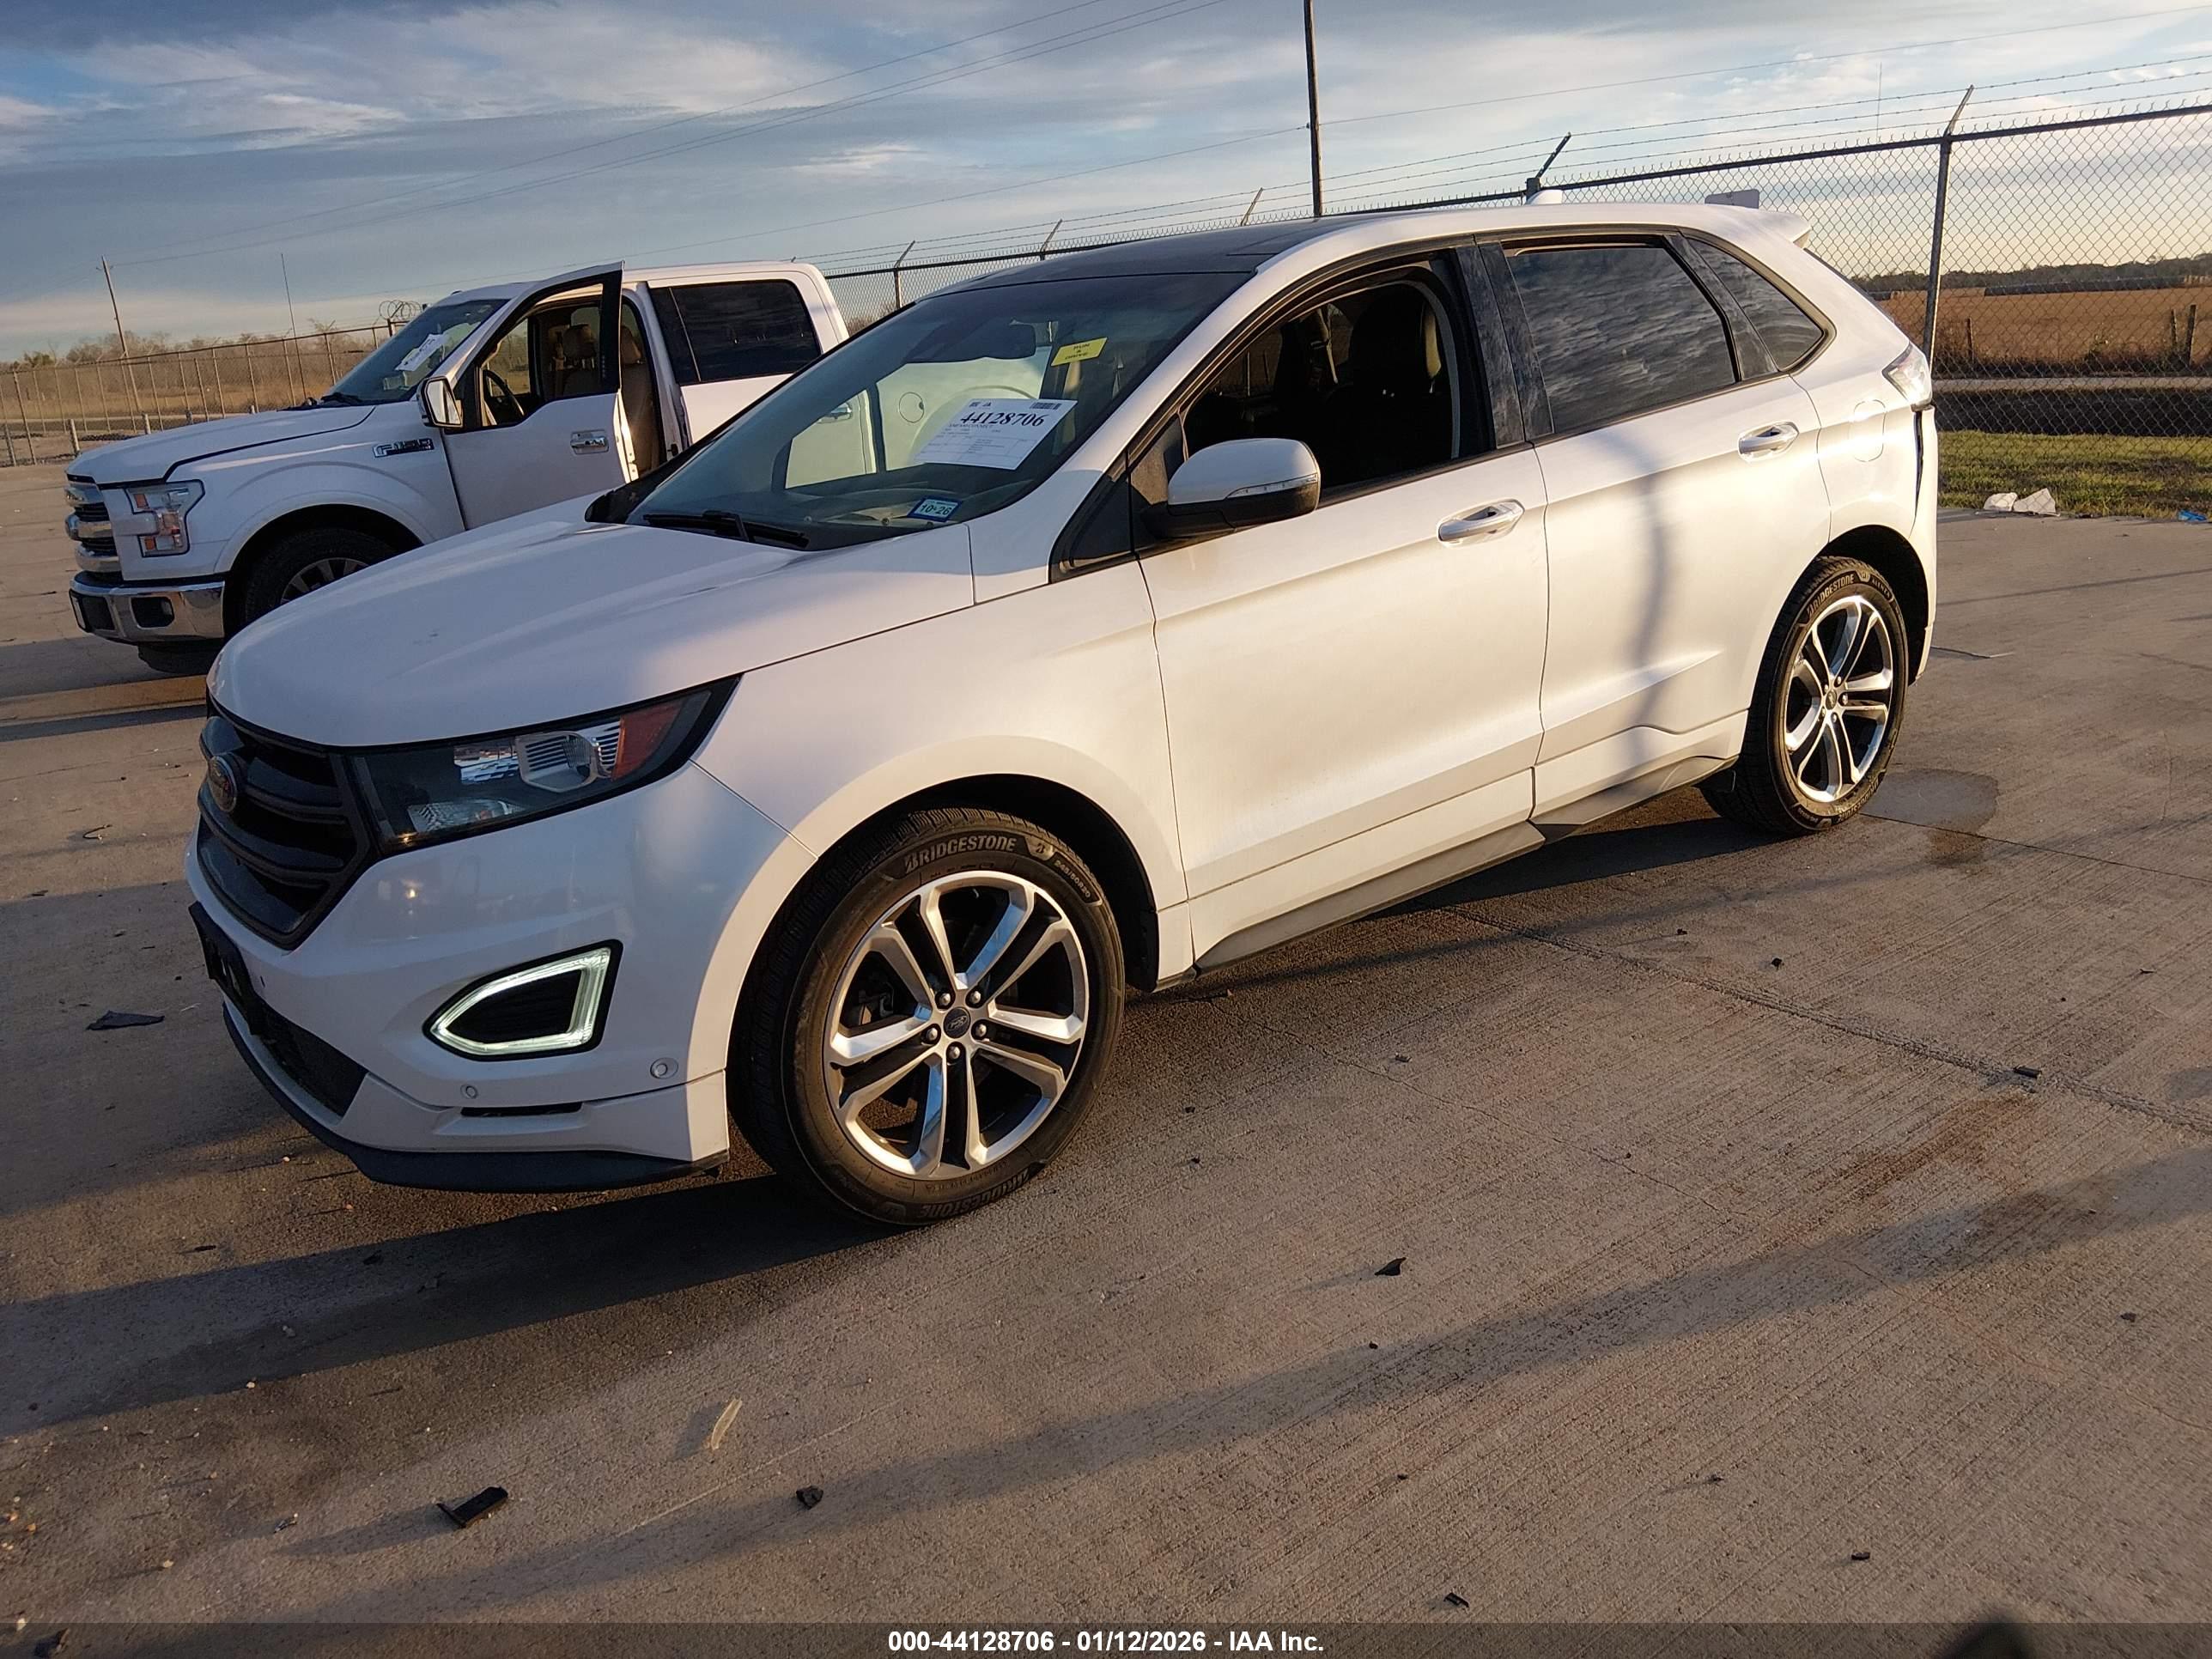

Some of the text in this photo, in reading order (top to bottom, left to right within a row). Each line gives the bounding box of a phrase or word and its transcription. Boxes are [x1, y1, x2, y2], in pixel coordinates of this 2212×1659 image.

[960, 411, 1049, 428] 44128706
[1806, 574, 1855, 617] BRIDGESTONE
[904, 835, 1018, 874] BRIDGESTONE
